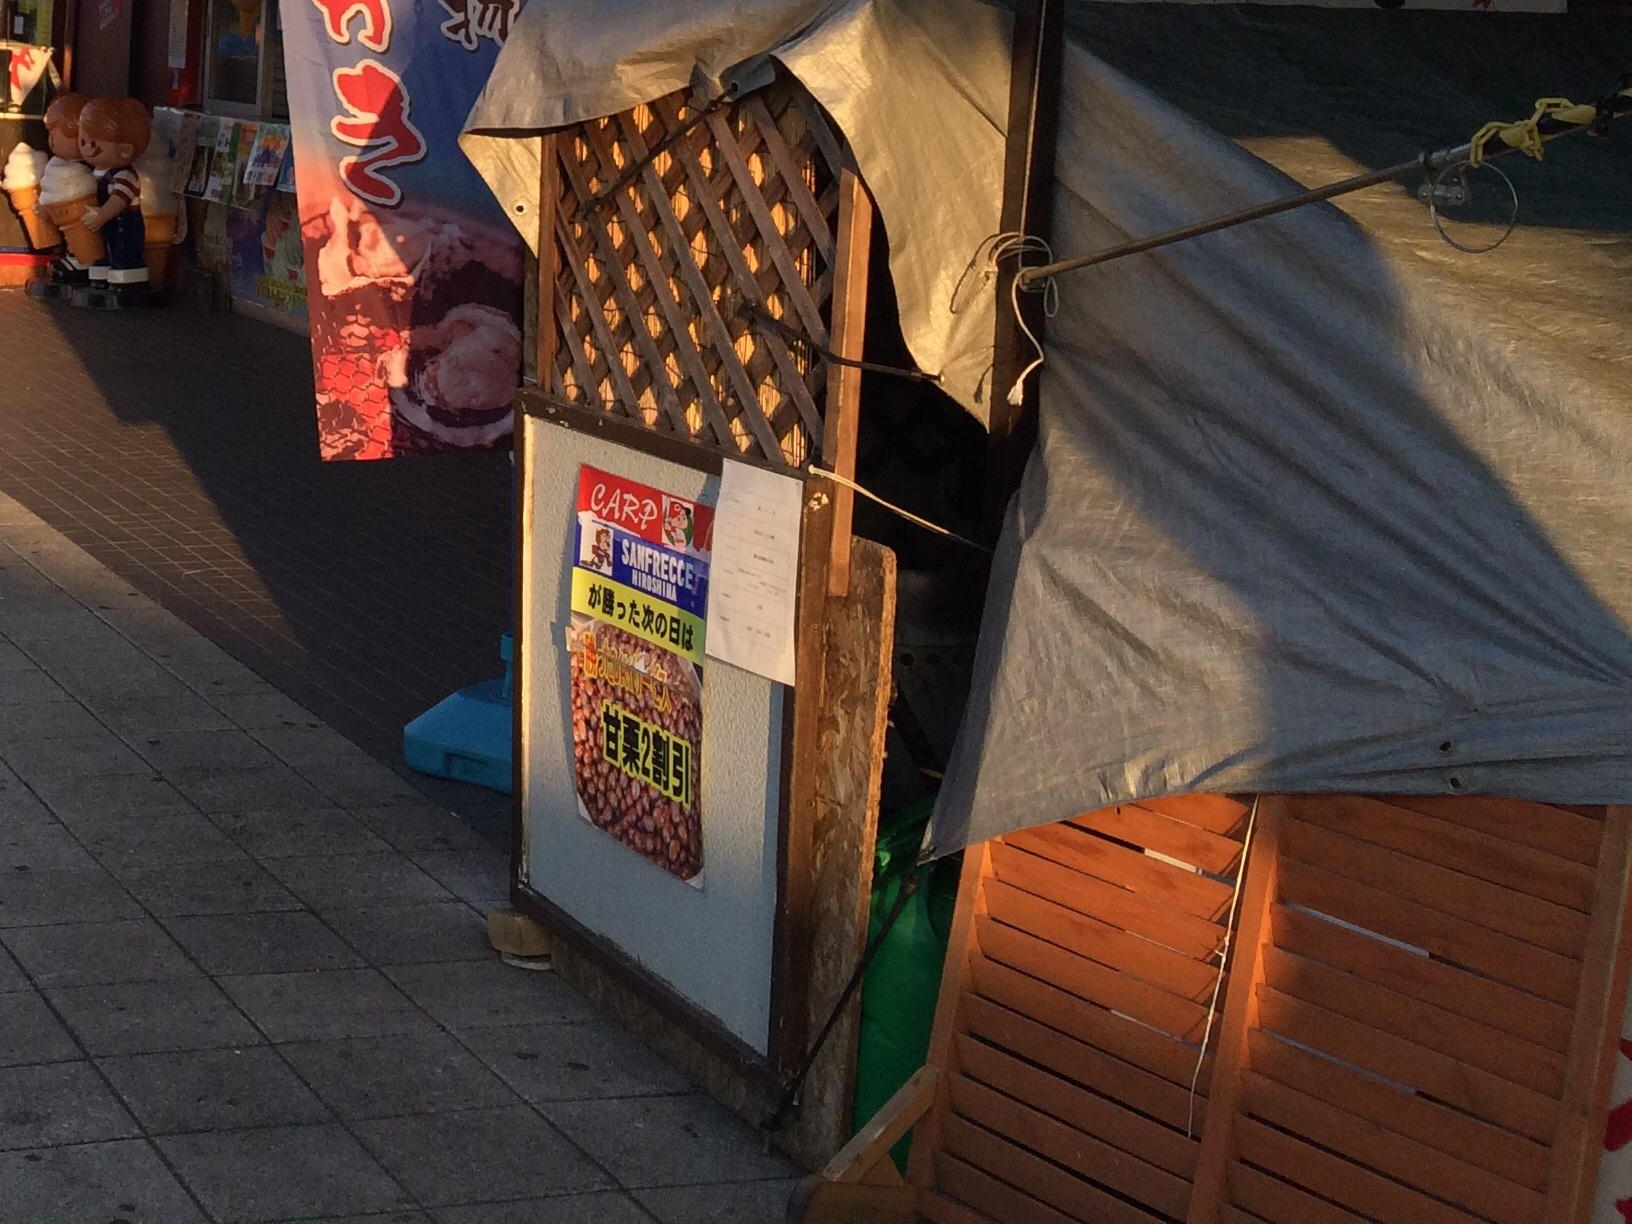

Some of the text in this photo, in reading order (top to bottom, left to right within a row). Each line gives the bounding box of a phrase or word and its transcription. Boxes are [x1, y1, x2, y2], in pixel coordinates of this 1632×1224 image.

[590, 483, 658, 530] CARP
[621, 539, 694, 591] SANFRECCE
[631, 569, 677, 602] HIROSHIMA
[587, 583, 694, 652] が勝った次の日は
[603, 704, 689, 805] 甘栗2割引
